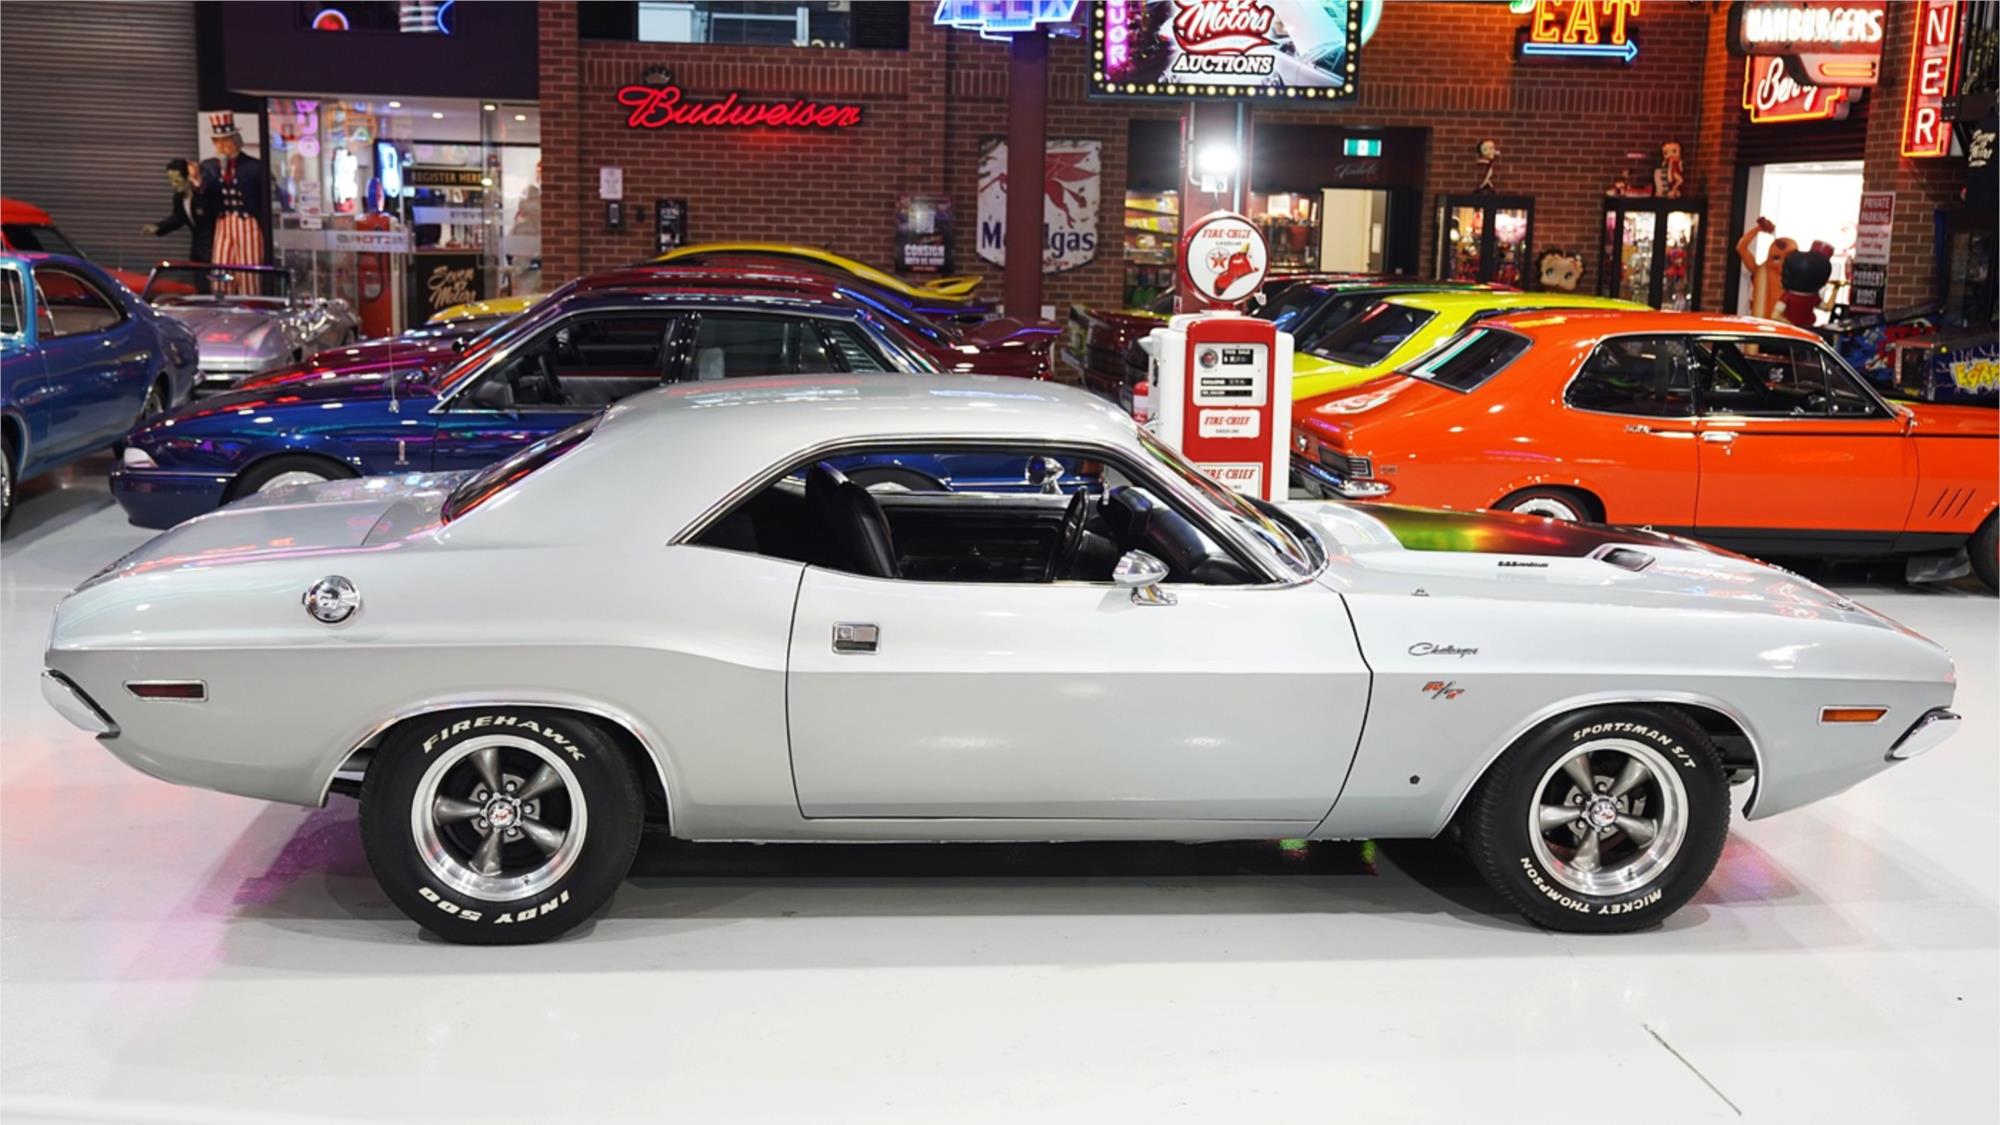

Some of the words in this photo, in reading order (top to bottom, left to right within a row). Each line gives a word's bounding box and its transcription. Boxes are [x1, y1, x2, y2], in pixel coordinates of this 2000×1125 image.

[1176, 1, 1272, 40] Motors
[1532, 0, 1640, 44] EAT
[1746, 7, 1884, 42] HAMBURGERS
[1173, 54, 1274, 74] AUCTIONS
[617, 85, 861, 128] Budweiser
[982, 222, 1095, 259] Mlgas
[1421, 681, 1465, 700] R/T
[423, 715, 586, 761] FIREHAWK
[1573, 722, 1672, 746] SPORTSMAN
[1672, 745, 1696, 768] S/T
[1520, 856, 1590, 913] THOMPSON
[1598, 888, 1662, 914] MICKEY
[418, 886, 482, 922] 500
[494, 889, 570, 924] INDY
